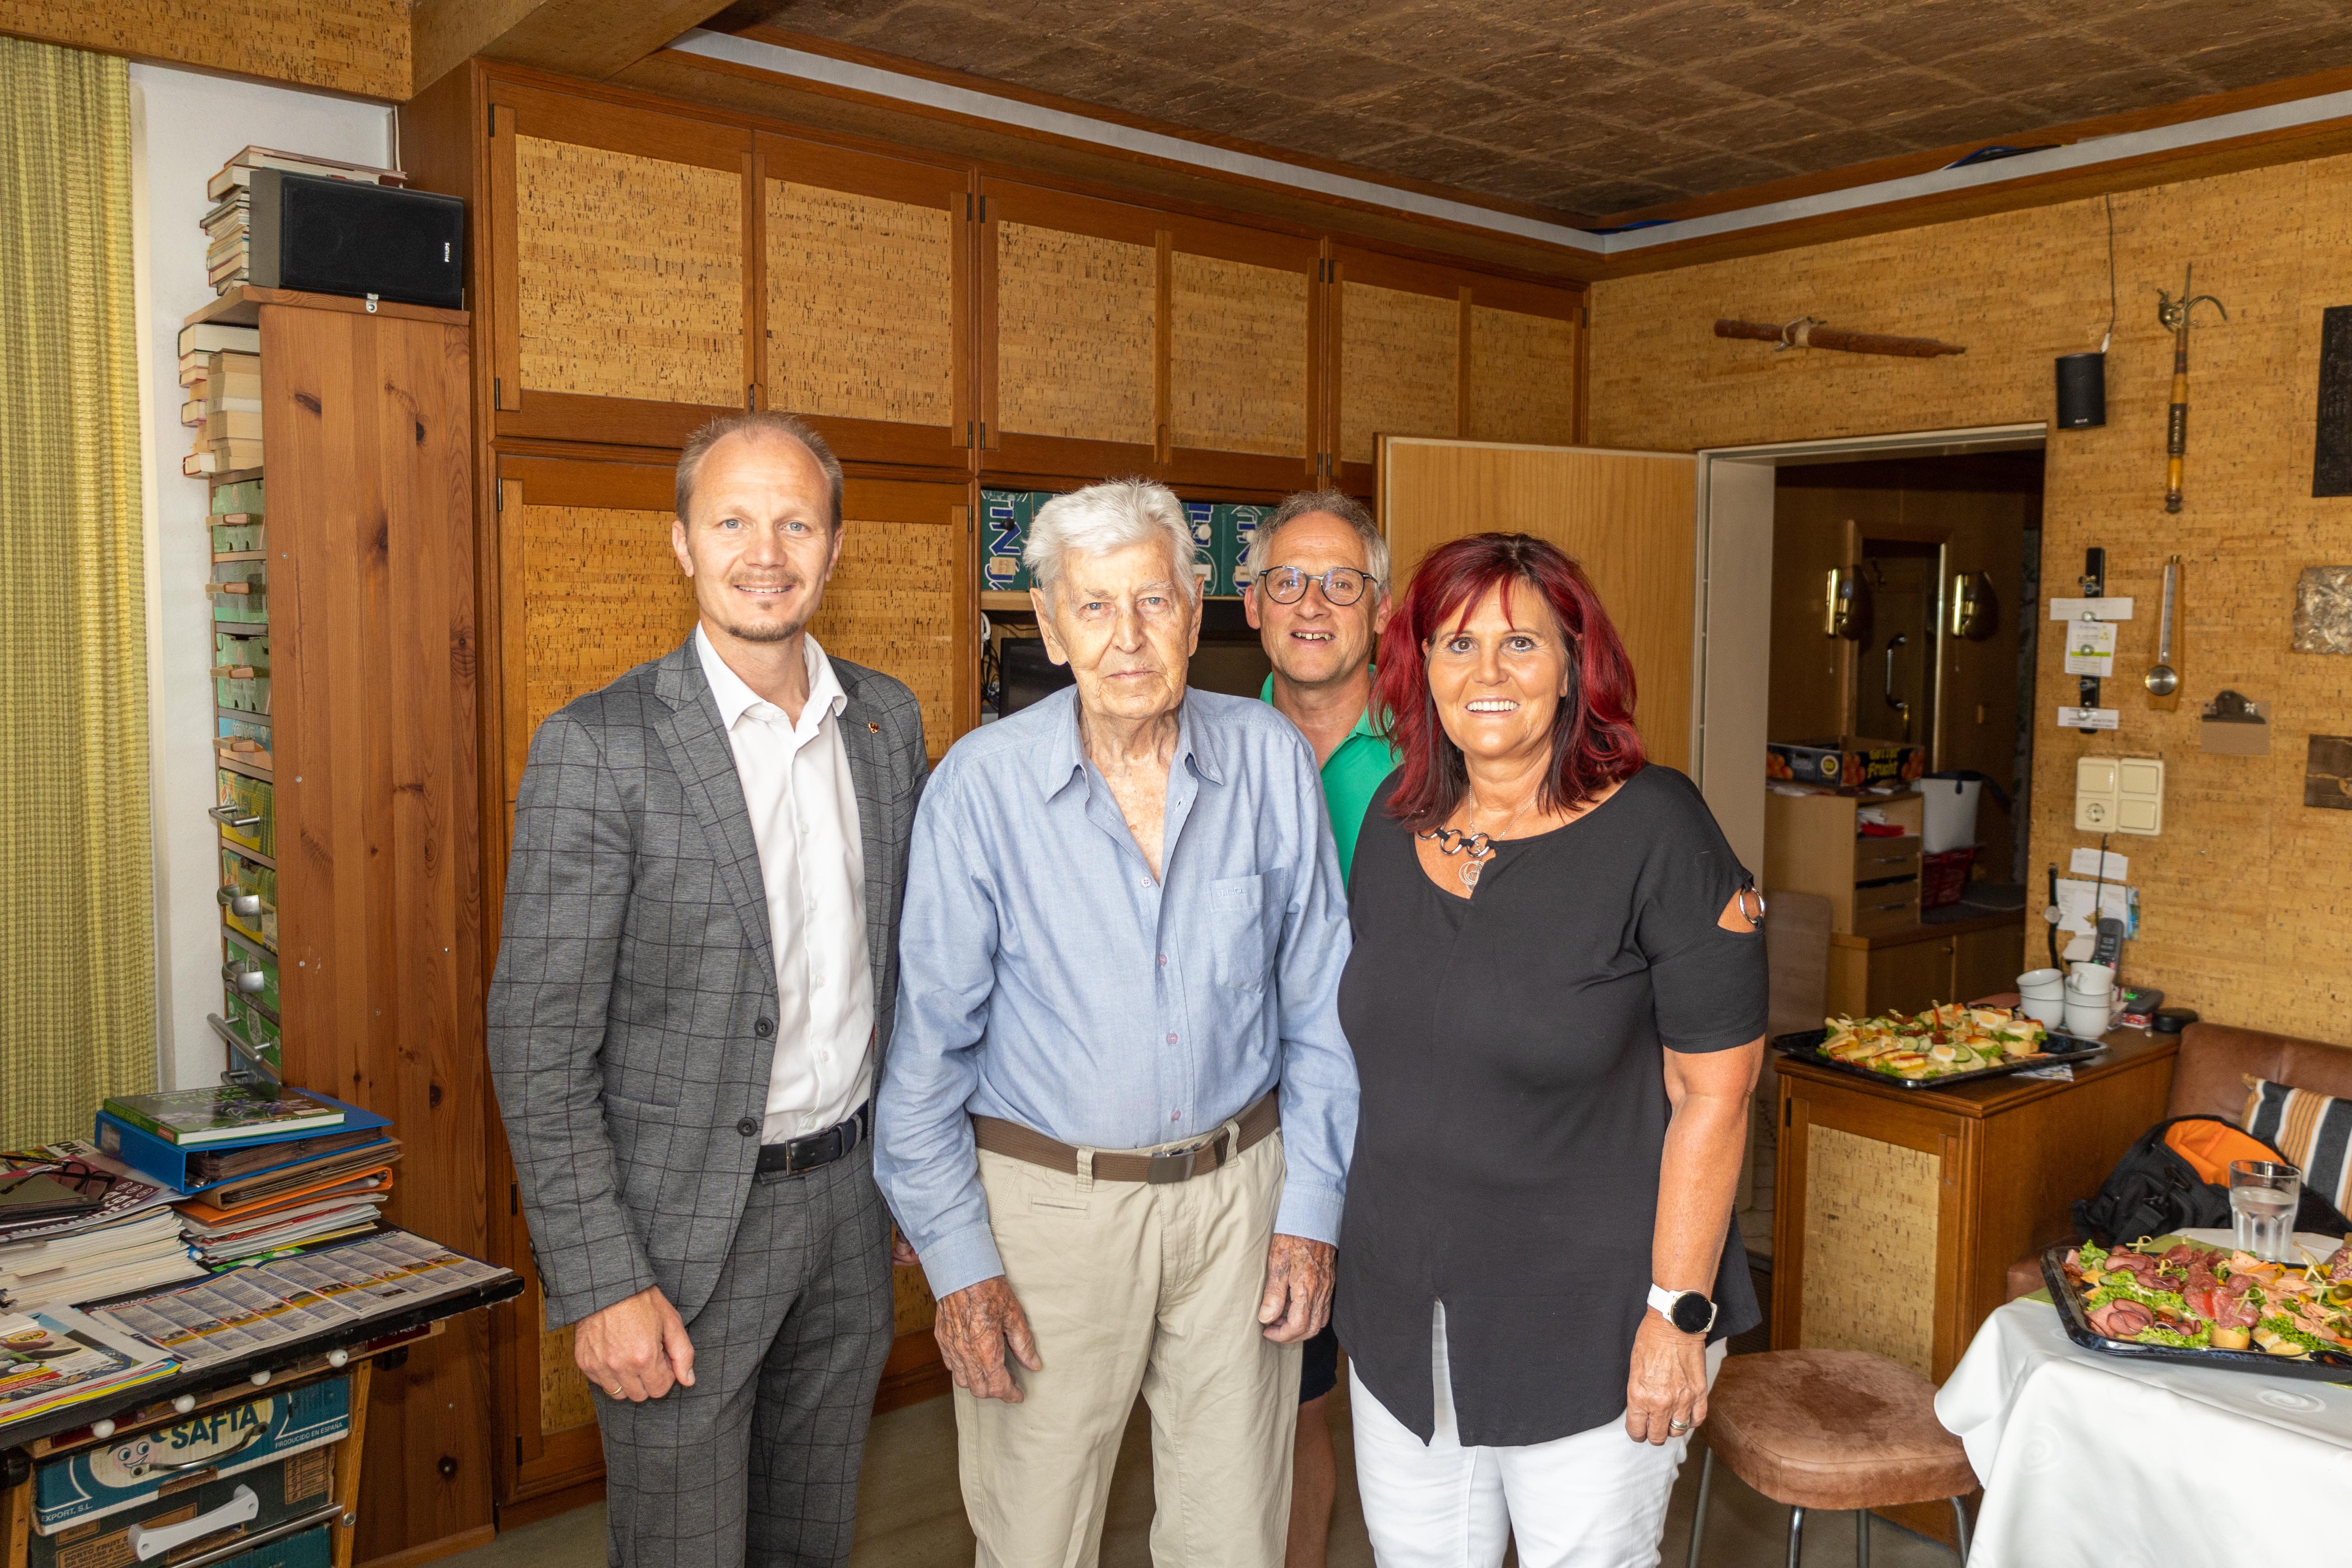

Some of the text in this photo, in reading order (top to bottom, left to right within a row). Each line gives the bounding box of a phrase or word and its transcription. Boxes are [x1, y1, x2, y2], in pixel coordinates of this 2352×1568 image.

[94, 1297, 147, 1310] MONTAG
[171, 1404, 260, 1449] SAFTA
[275, 1434, 310, 1449] PRODUCIDO
[321, 1422, 343, 1434] ESPAÑA
